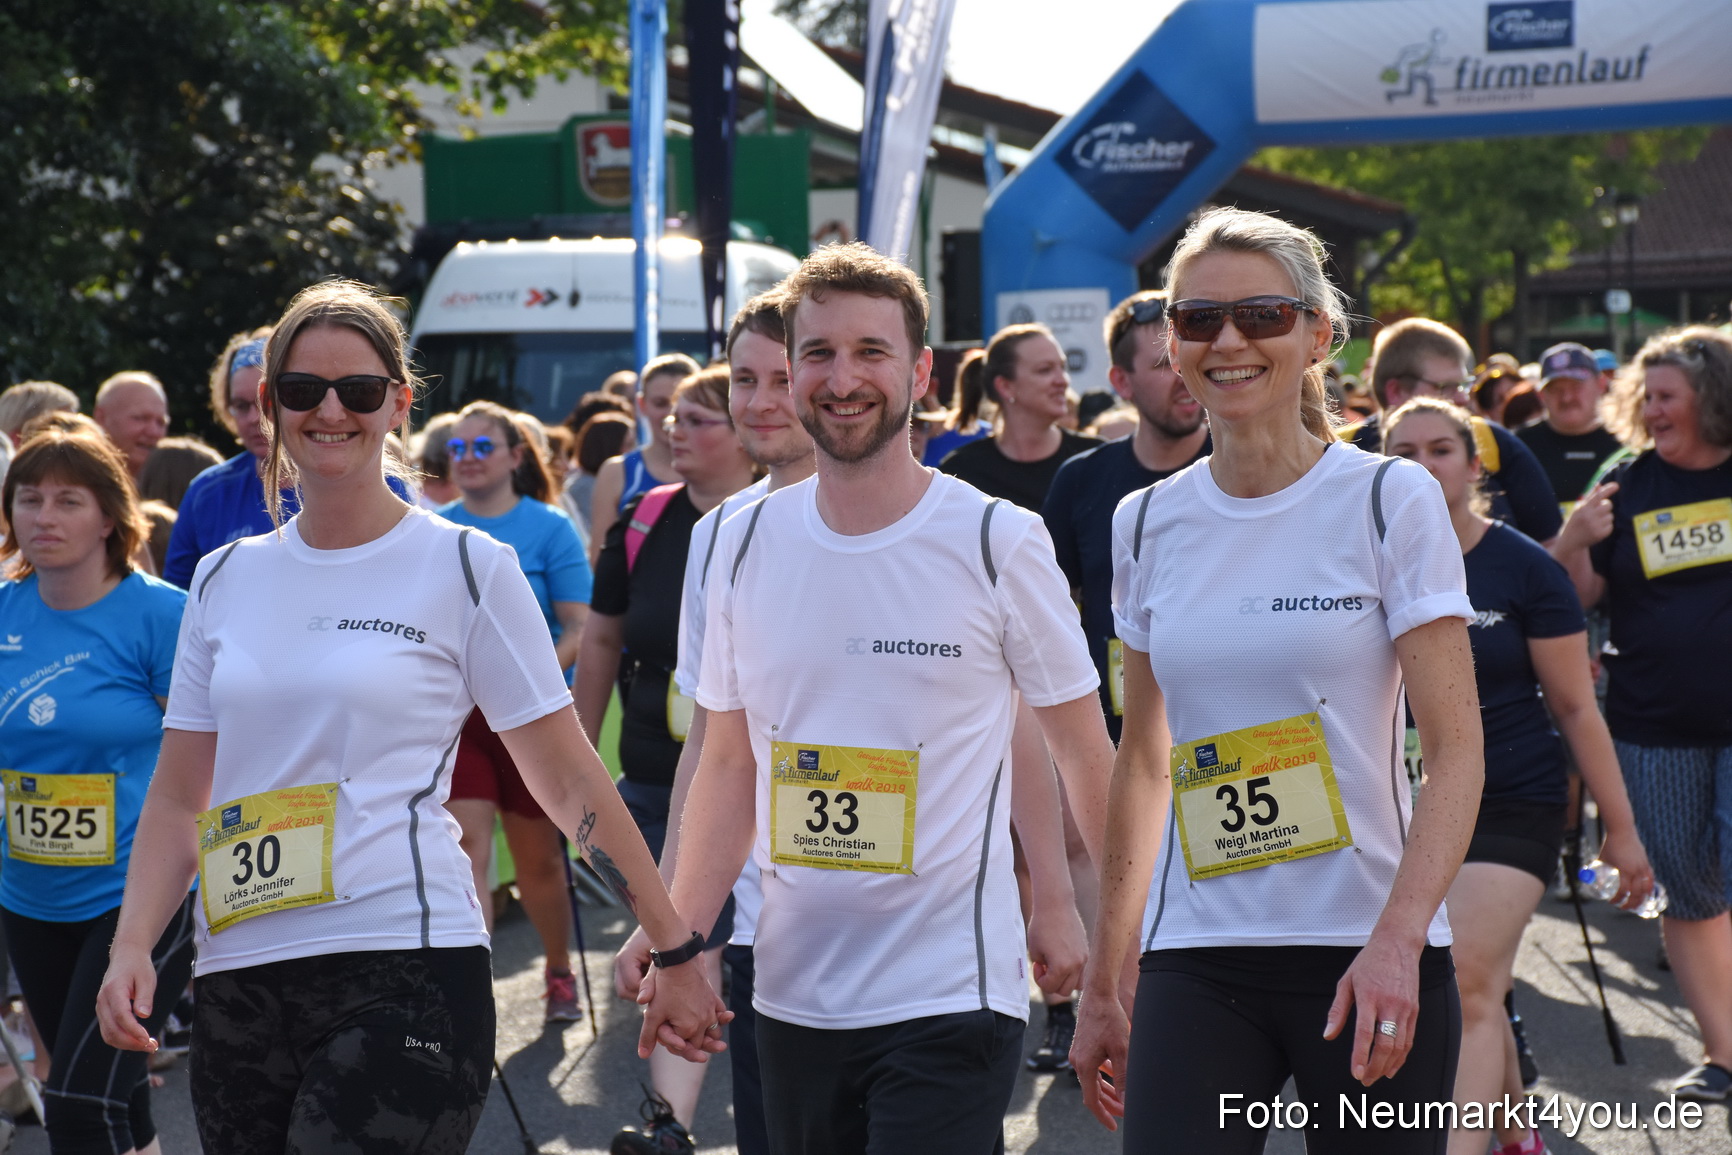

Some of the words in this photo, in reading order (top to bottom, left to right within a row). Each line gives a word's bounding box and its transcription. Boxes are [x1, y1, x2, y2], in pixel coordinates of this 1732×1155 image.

[1456, 44, 1651, 91] firmenlauf
[1085, 130, 1194, 163] Fischer
[1652, 523, 1725, 554] 1458
[1271, 595, 1363, 612] auctores
[337, 618, 427, 644] auctores
[65, 651, 90, 665] Bau
[872, 639, 962, 657] auctores
[788, 767, 840, 782] firmenlauf
[1190, 757, 1241, 782] firmenlauf
[1252, 756, 1281, 775] walk
[1284, 752, 1316, 769] 2019
[846, 778, 874, 791] walk
[876, 782, 906, 793] 2019
[806, 790, 859, 835] 33
[1215, 776, 1279, 833] 35
[15, 804, 97, 839] 1525
[214, 816, 262, 842] firmenlauf
[267, 816, 293, 832] walk
[295, 815, 324, 828] 2019
[30, 839, 46, 848] Fink
[48, 841, 74, 851] Birgit
[793, 833, 819, 847] Spies
[822, 836, 875, 850] Christian
[1215, 833, 1247, 850] Weigl
[1250, 825, 1300, 844] Martina
[232, 835, 280, 886] 30
[802, 848, 834, 858] Auctores
[836, 851, 860, 859] GmbH
[1226, 846, 1262, 860] Auctores
[1264, 839, 1292, 852] GmbH
[224, 889, 248, 904] Lörks
[251, 877, 295, 895] Jennifer
[231, 898, 259, 911] Auctores
[261, 891, 284, 902] GmbH
[405, 1035, 422, 1047] USA
[425, 1042, 441, 1053] PRO
